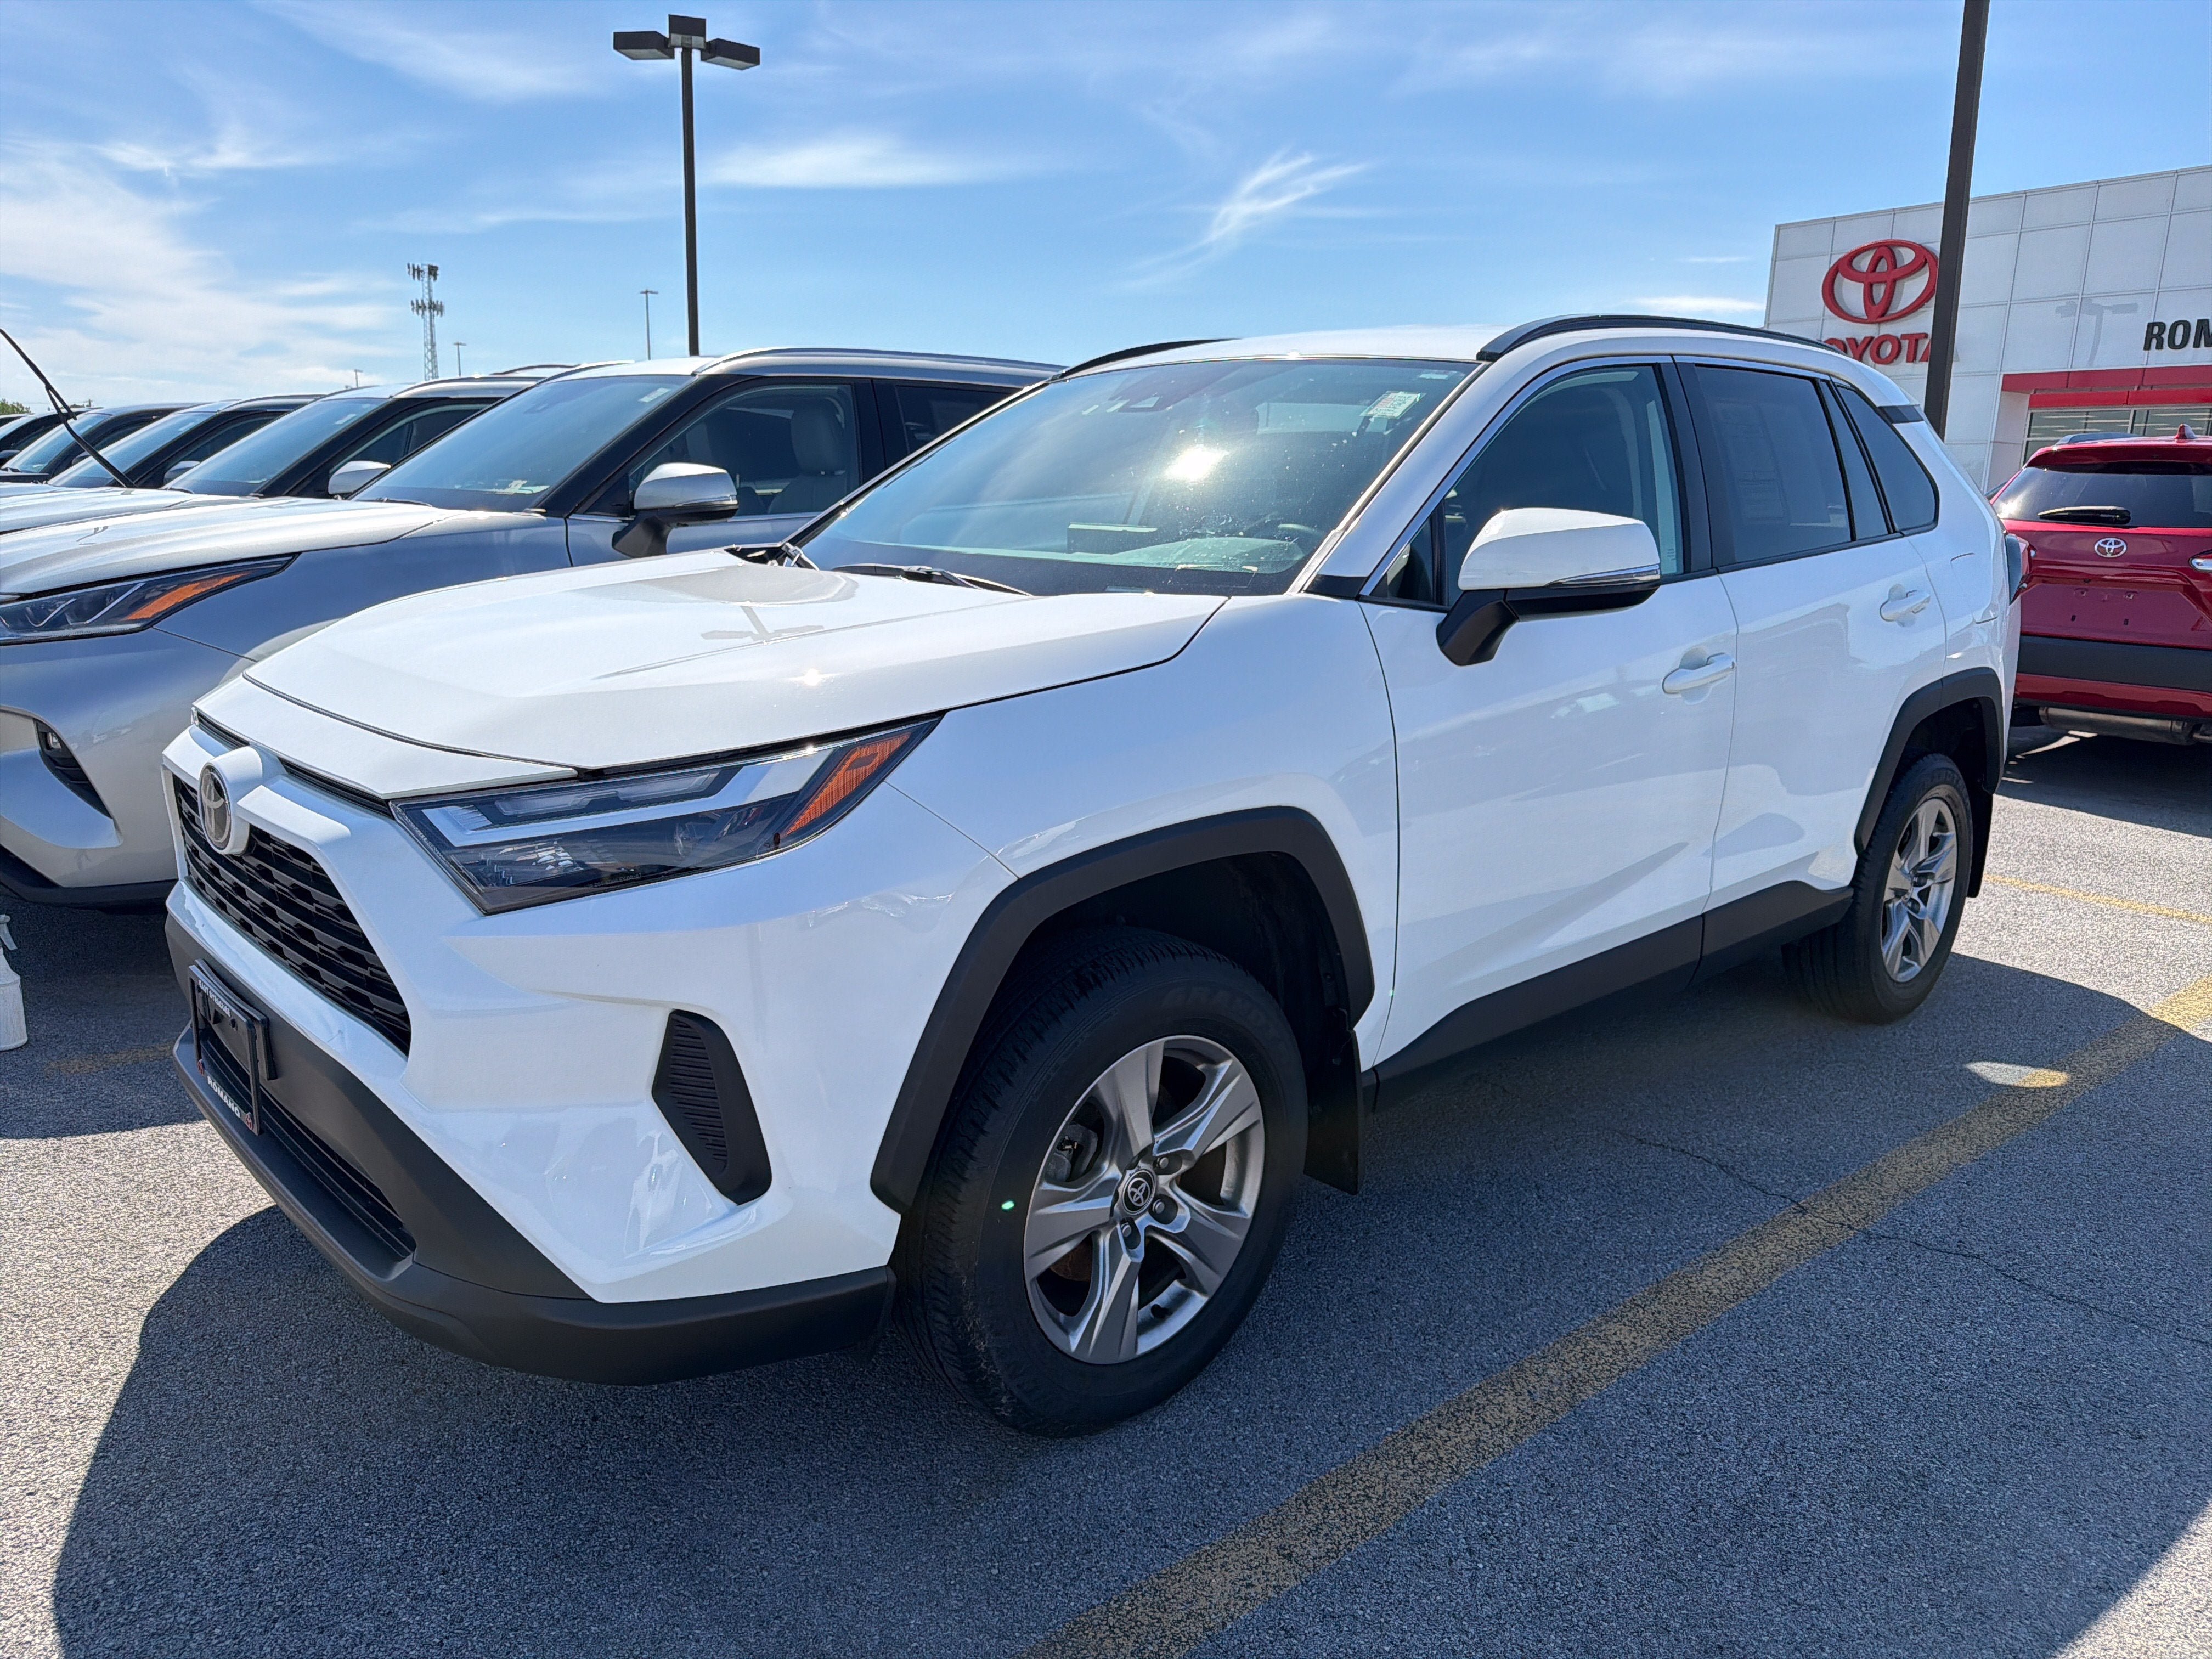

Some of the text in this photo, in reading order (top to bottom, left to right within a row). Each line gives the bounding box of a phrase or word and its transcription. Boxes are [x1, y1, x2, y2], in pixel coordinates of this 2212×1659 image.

[1824, 332, 1931, 365] YOT
[2143, 318, 2212, 351] ROM
[198, 979, 208, 996] EAST
[207, 1075, 240, 1118] ROMANO
